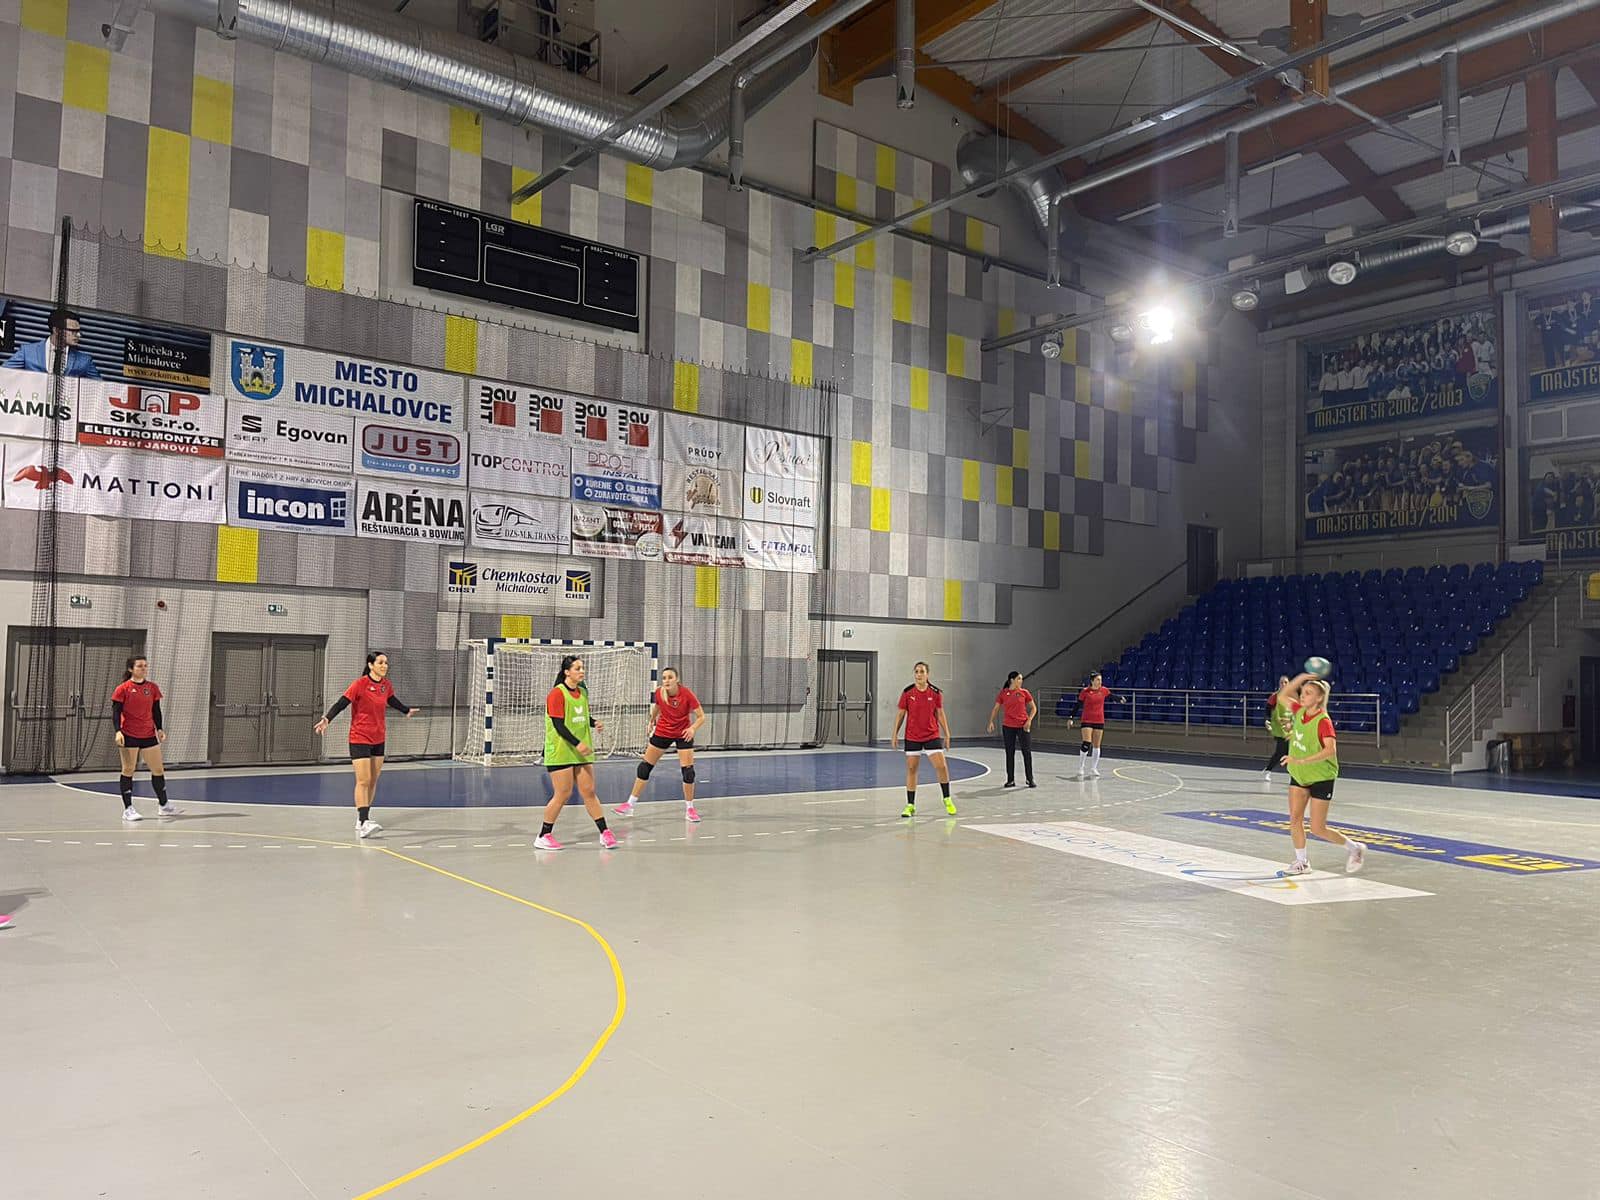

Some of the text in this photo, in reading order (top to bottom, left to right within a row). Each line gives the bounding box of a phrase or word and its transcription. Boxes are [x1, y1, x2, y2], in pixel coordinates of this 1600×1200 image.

[486, 222, 505, 234] LGR
[128, 353, 182, 369] Michalovce
[335, 360, 418, 392] MESTO
[1541, 364, 1600, 393] MAJSTE
[295, 381, 453, 423] MICHALOVCE
[1315, 388, 1463, 428] MAJSTER SR 2002/2003
[110, 410, 201, 432] SK, s.r.o.
[276, 419, 348, 444] Egovan
[106, 437, 200, 454] Jozef JANOVIČ
[233, 433, 268, 443] SEAT
[371, 433, 453, 459] JUST
[688, 447, 722, 460] PRÚDY
[471, 453, 569, 477] TOPCONTROL
[82, 473, 214, 501] MATTONI
[247, 489, 325, 519] incon
[362, 489, 464, 528] ARÉNA
[767, 491, 811, 507] Slovnaft
[1316, 504, 1458, 535] MAJSTER SR 2013/2014
[429, 529, 465, 541] BOWLING
[691, 533, 736, 549] VALTEAM
[761, 540, 813, 553] FATRAFOL
[482, 568, 561, 584] Chemkostav
[495, 582, 548, 594] Michalovce
